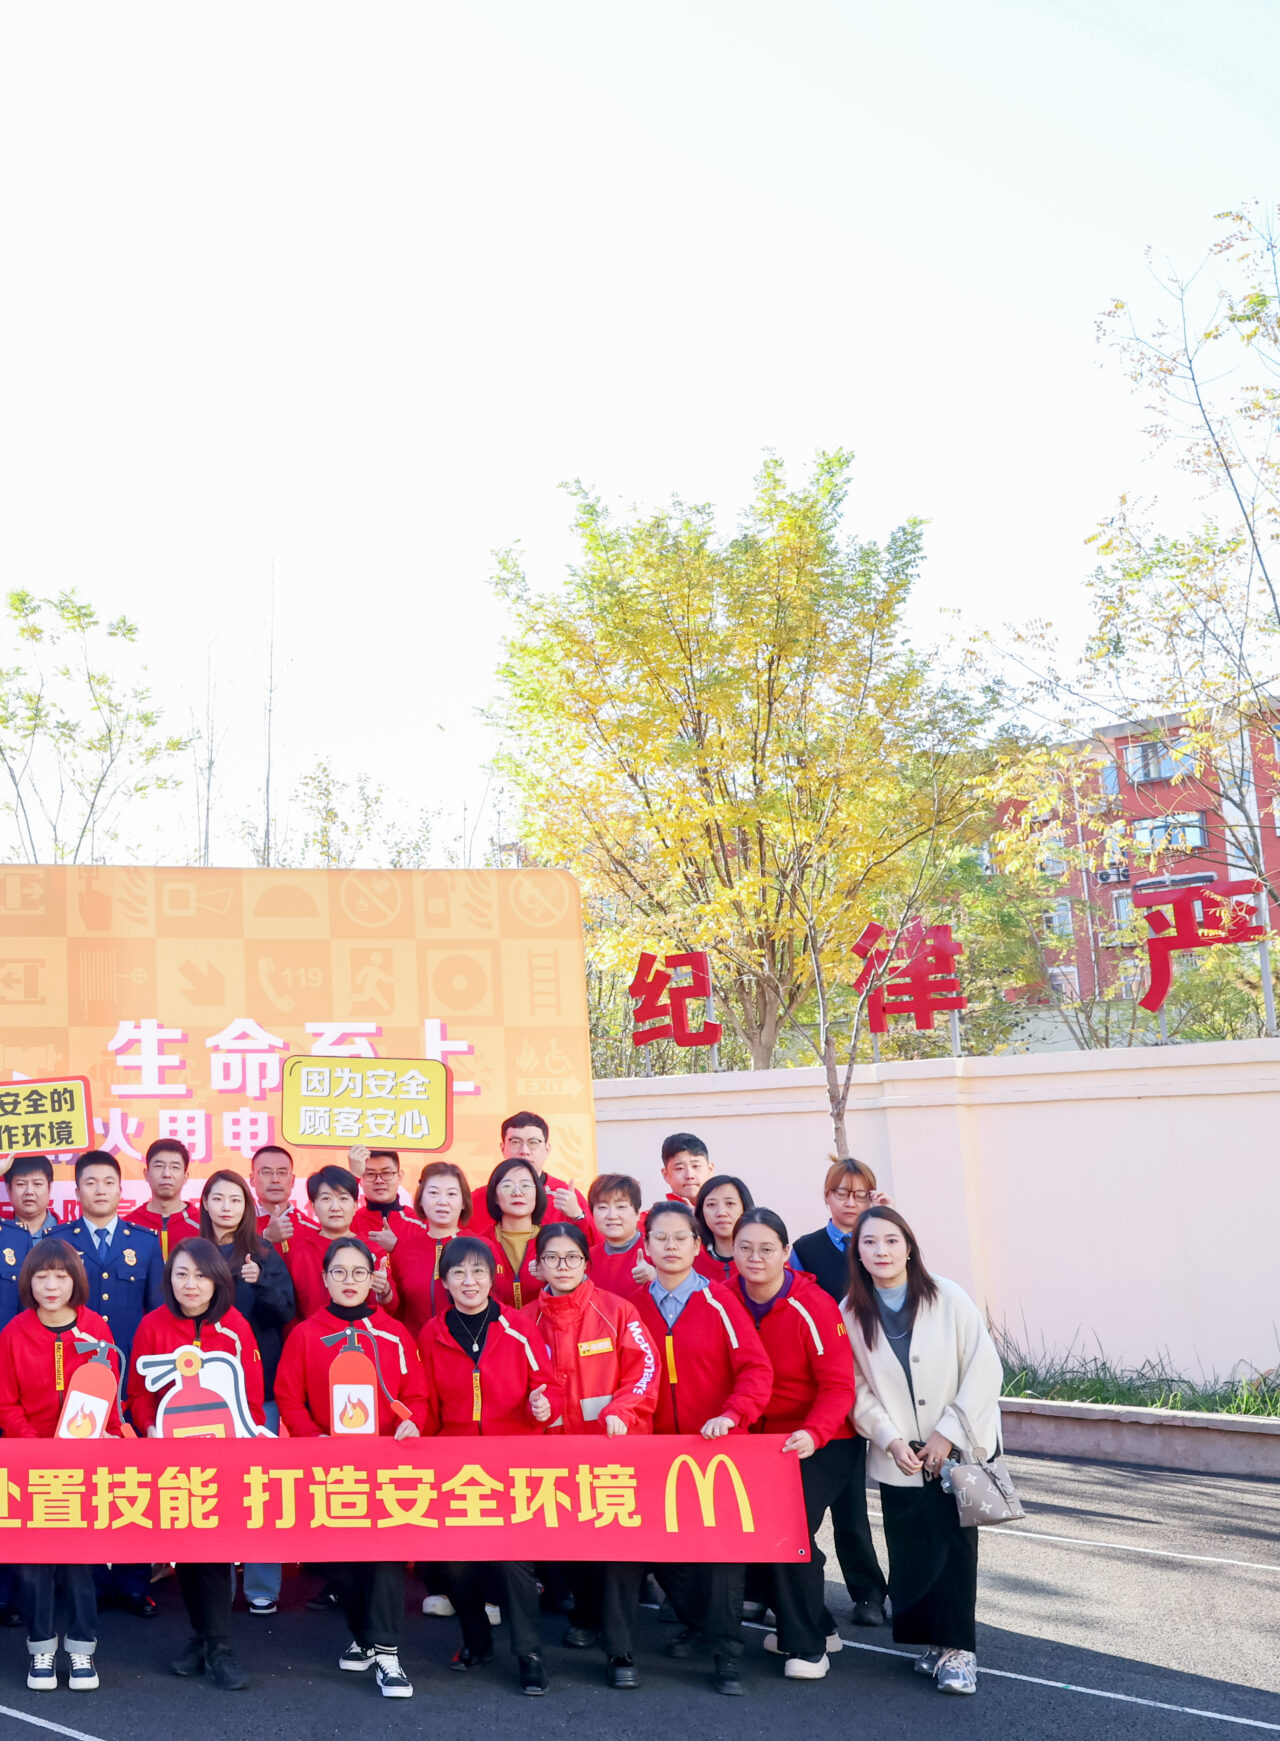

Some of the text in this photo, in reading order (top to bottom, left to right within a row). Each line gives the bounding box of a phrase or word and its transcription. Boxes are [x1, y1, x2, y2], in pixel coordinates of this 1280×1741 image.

[280, 967, 324, 988] 119
[300, 1066, 431, 1100] 因为安全
[525, 1079, 567, 1095] EXIT
[299, 1106, 431, 1140] 顾客安心
[242, 1463, 642, 1529] 打造安全环境
